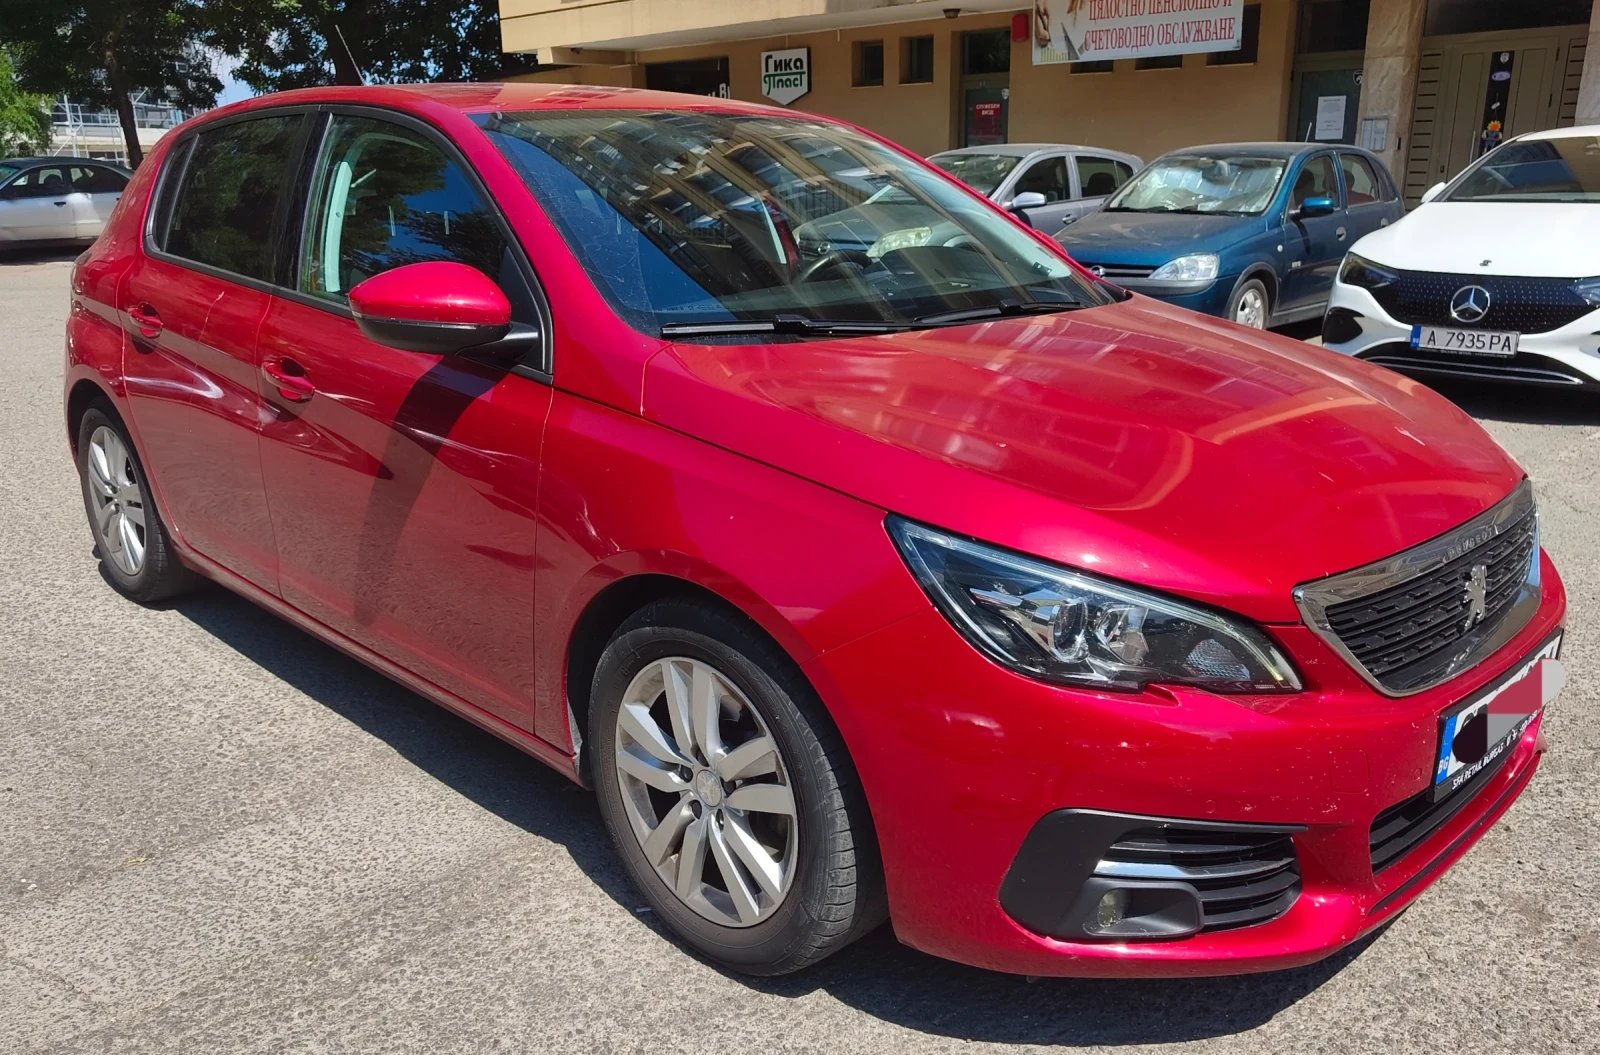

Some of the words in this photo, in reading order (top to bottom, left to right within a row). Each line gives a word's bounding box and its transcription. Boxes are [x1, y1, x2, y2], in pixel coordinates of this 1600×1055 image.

[1084, 24, 1154, 52] СЧЕТОВОДНО
[1157, 17, 1235, 46] ОБСЛУЖВАНЕ
[765, 54, 804, 73] Гика
[1445, 331, 1486, 350] 7935
[1489, 334, 1512, 352] PA
[1437, 756, 1450, 775] BG
[1452, 774, 1466, 790] SFA
[1463, 760, 1483, 782] RETAIL
[1483, 743, 1504, 767] BURGAS
